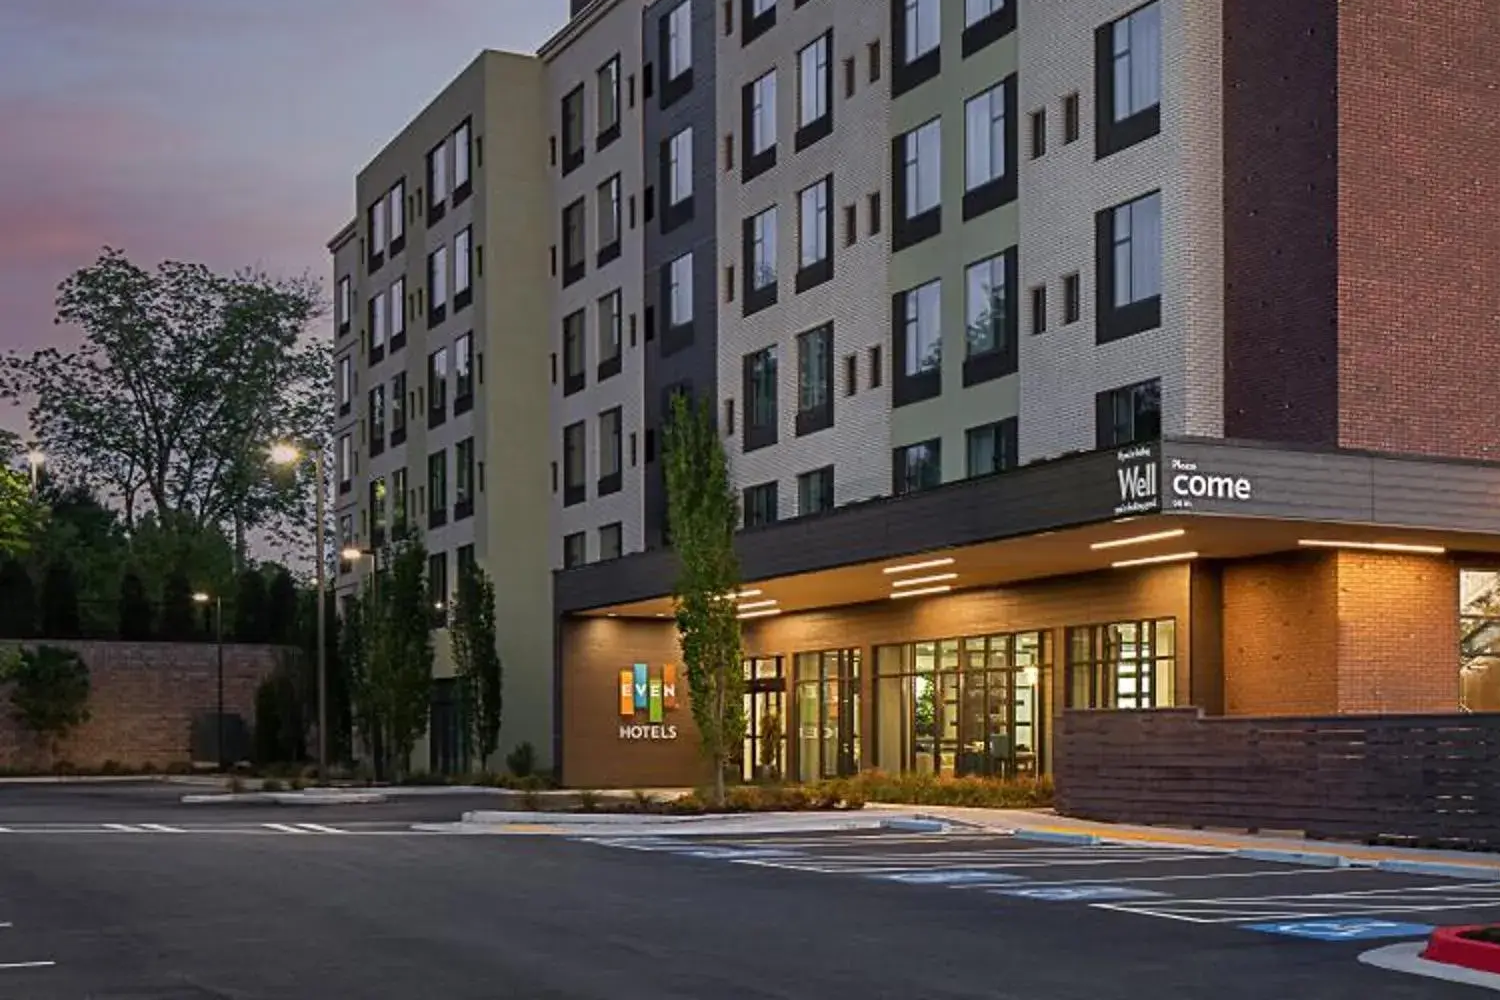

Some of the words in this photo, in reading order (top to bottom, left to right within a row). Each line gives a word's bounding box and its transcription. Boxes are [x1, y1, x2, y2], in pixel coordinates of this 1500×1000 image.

[1117, 461, 1157, 501] Well
[1172, 474, 1251, 500] come
[621, 683, 676, 697] EVEN
[619, 724, 678, 739] HOTELS
